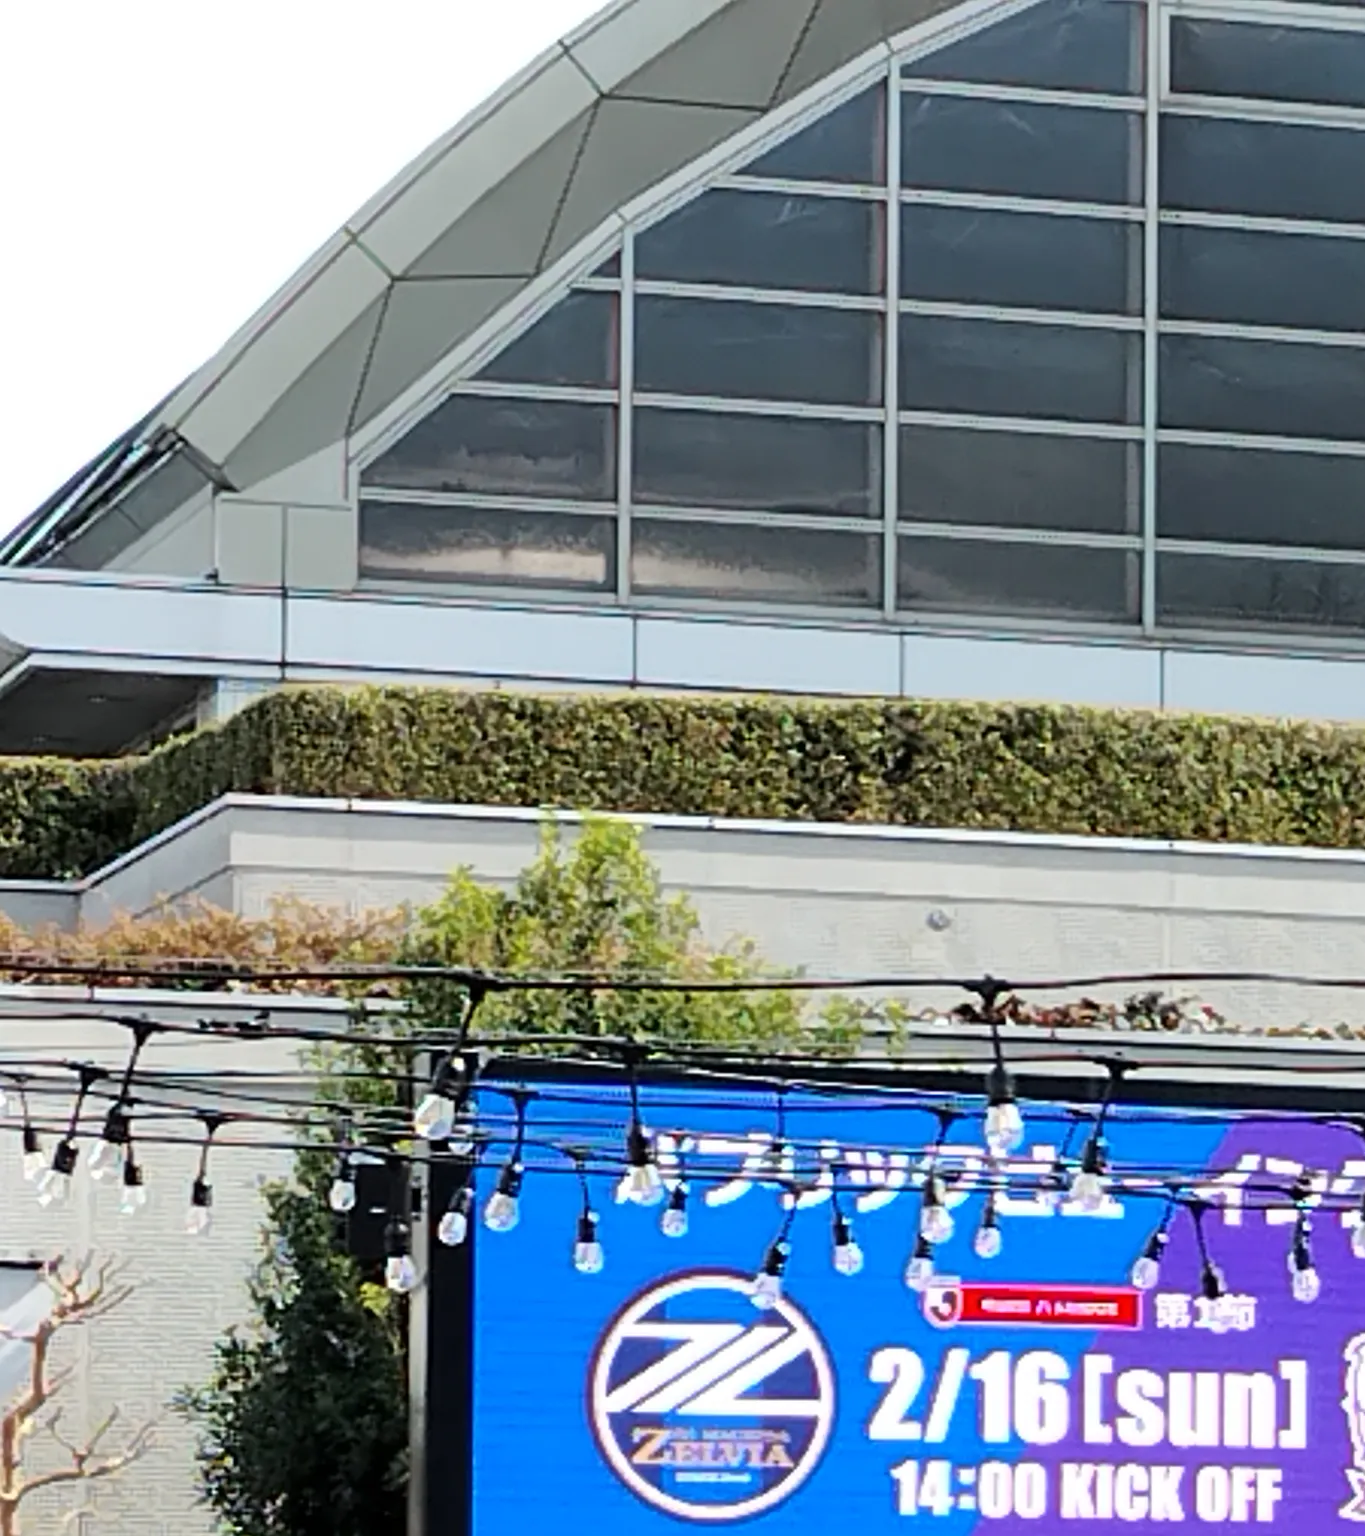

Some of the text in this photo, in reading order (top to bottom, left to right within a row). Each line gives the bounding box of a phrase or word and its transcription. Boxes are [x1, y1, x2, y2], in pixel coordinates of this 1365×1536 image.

[868, 1347, 1307, 1448] 2/16 [sun]
[890, 1460, 1283, 1523] 14:00 KICK OFF
